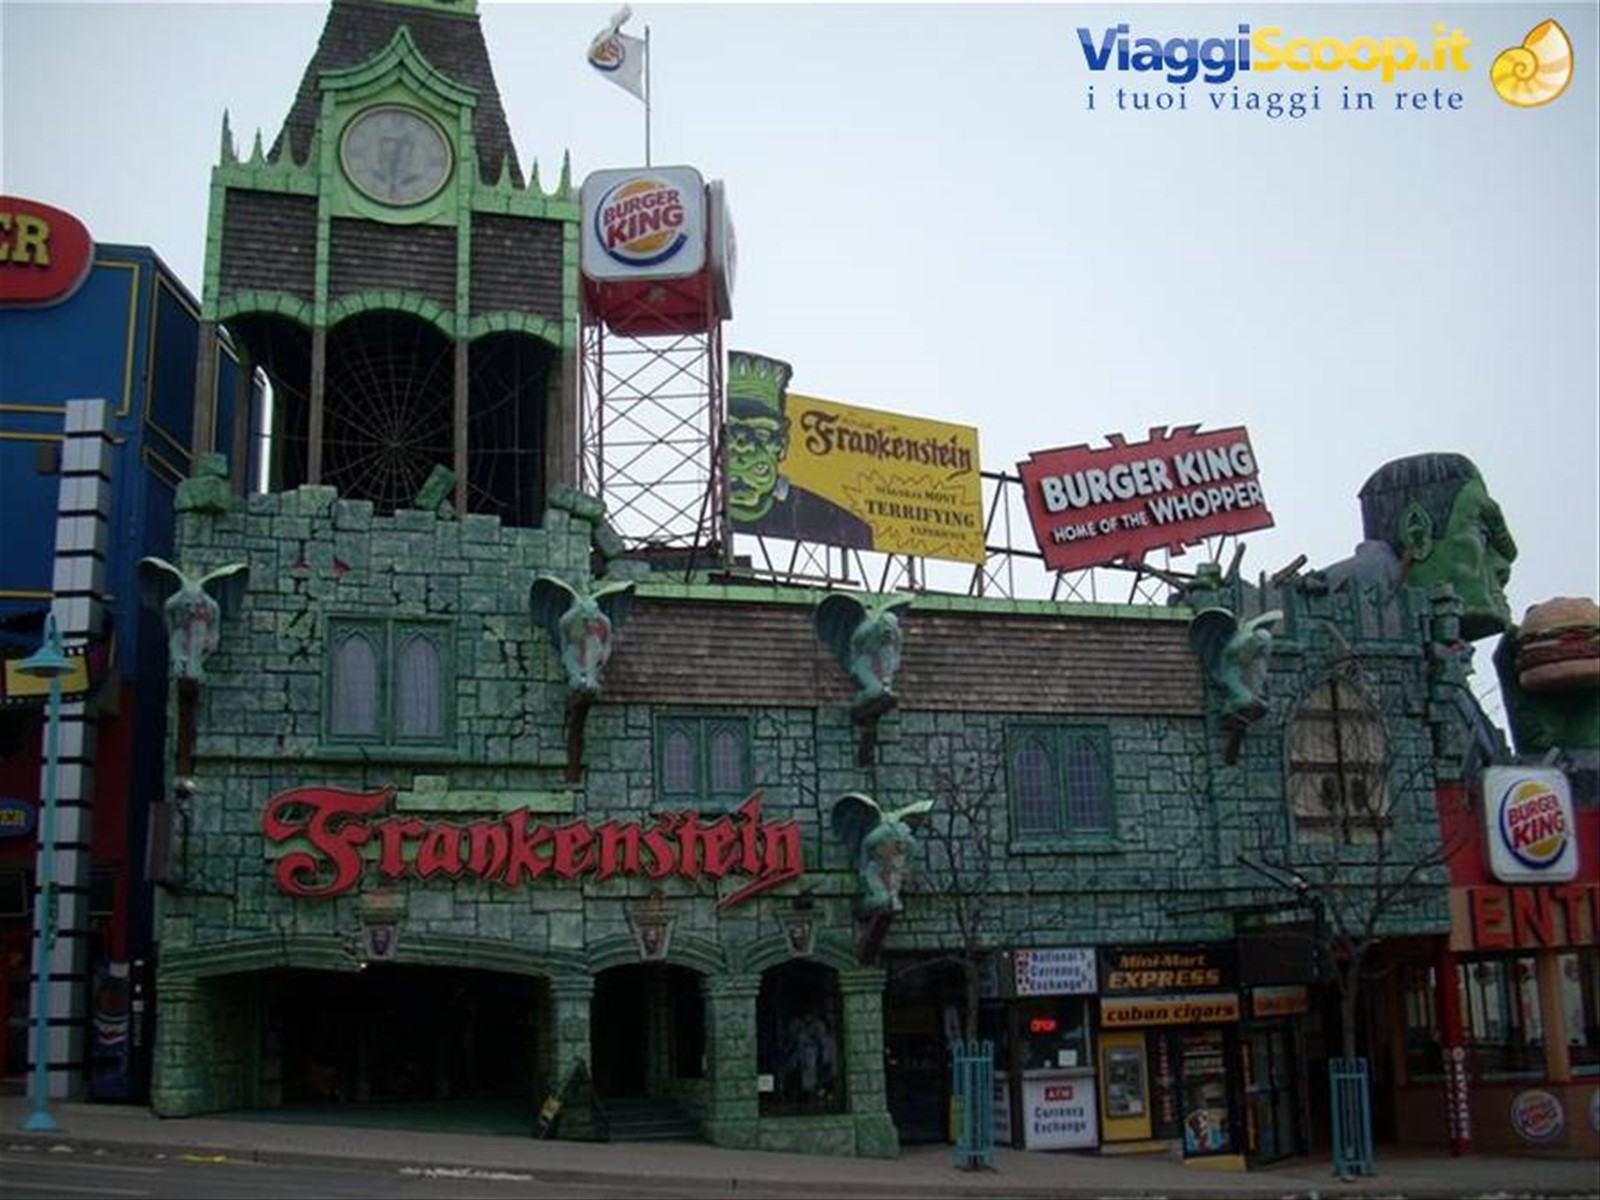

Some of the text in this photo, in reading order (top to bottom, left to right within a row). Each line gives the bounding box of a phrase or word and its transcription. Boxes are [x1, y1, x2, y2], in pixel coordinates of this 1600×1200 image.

[603, 188, 680, 226] BURGER
[605, 205, 684, 248] KING
[800, 410, 973, 481] Frankenstein
[1041, 442, 1255, 513] BURGER KING
[865, 499, 975, 528] TERRIFYING
[924, 489, 957, 505] MOST
[1054, 481, 1266, 543] HOME OF THE WHOPPER
[1507, 793, 1560, 826] BURGER
[262, 783, 801, 908] Frankenstein
[1512, 811, 1565, 850] KING
[1119, 953, 1208, 970] Mini-Mart
[1108, 968, 1221, 990] EXPRESS
[1106, 1004, 1168, 1022] cuban
[1173, 1002, 1235, 1022] cigars
[1033, 1119, 1087, 1134] Exchange
[1034, 1105, 1085, 1119] Currency
